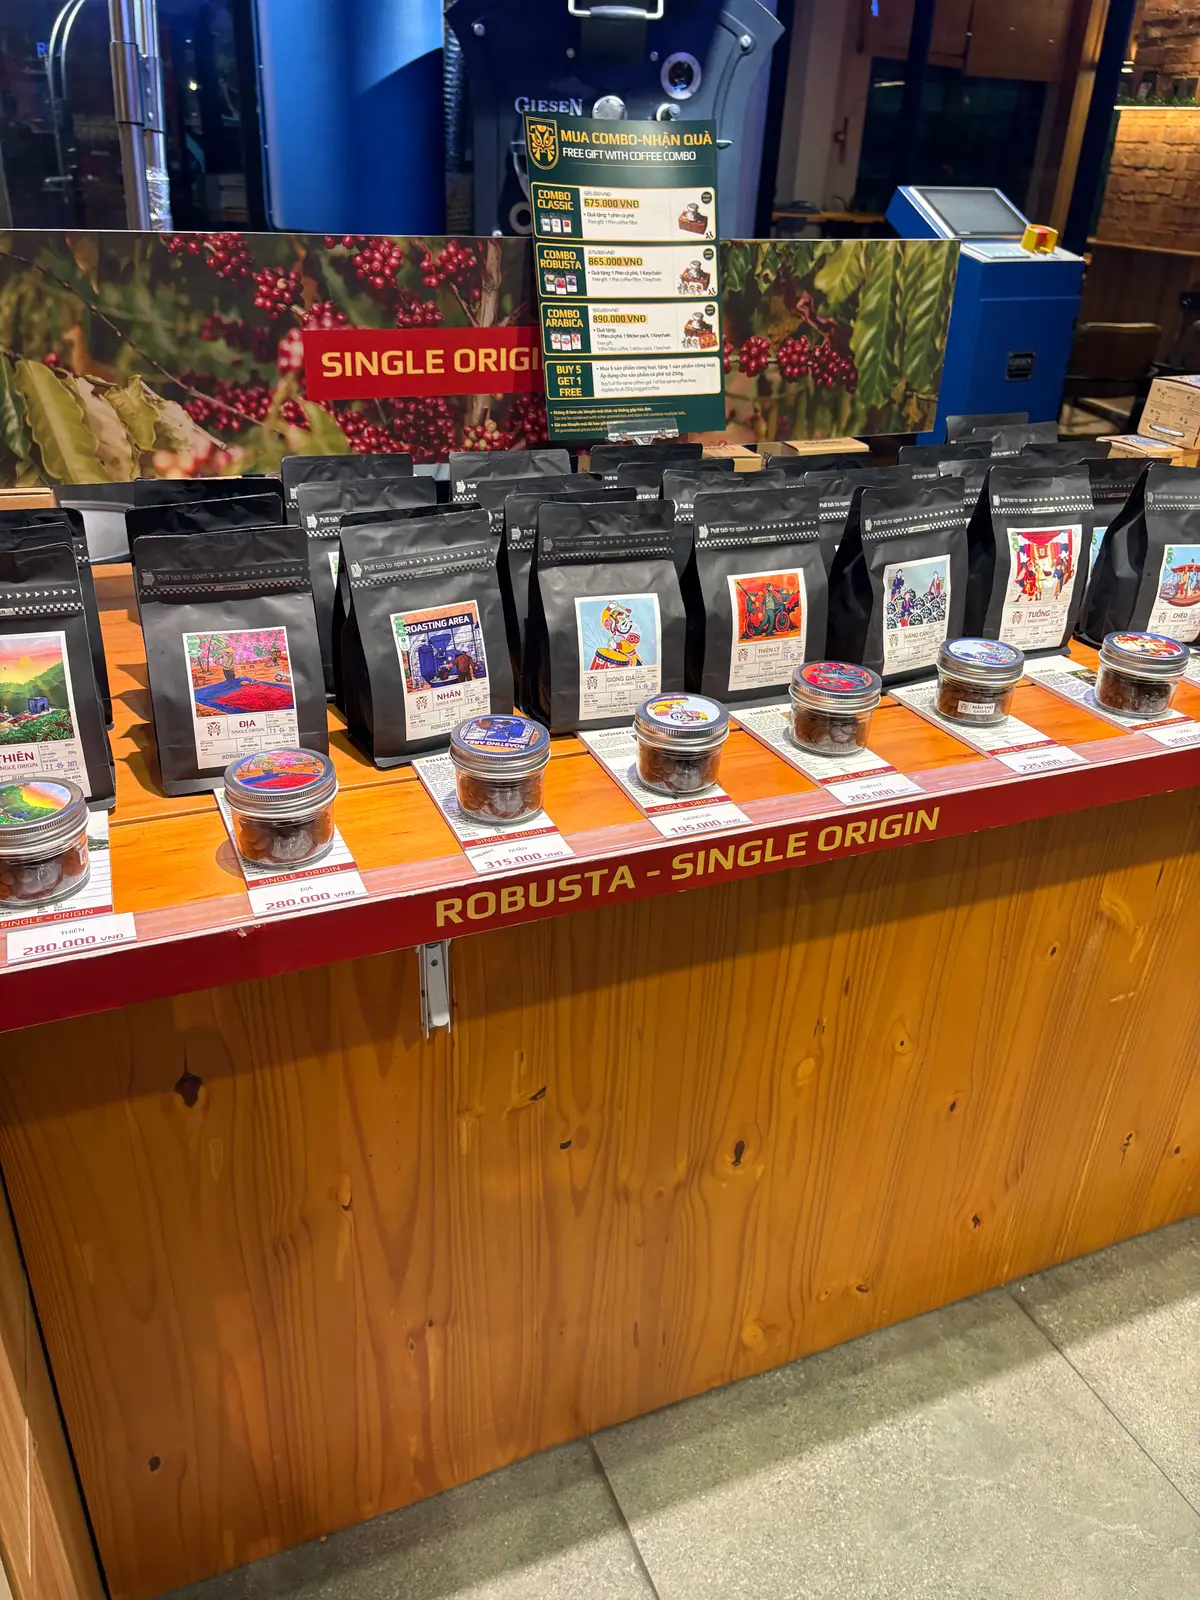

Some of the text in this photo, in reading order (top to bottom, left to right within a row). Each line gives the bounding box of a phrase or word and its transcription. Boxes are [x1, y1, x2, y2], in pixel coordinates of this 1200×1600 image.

[514, 96, 583, 116] GIESEN
[560, 130, 712, 148] MUA COMBO-NHẬN QUÀ
[562, 148, 696, 162] FREE GIFT WITH COFFEE COMBO
[538, 189, 571, 200] COMBO
[538, 200, 574, 211] CLASSIC
[584, 198, 640, 208] 675.000 VNĐ
[544, 250, 576, 260] COMBO
[540, 259, 582, 270] ROBUSTA
[588, 257, 643, 266] 865.000 VNĐ
[547, 309, 580, 318] COMBO
[593, 315, 626, 323] 890.000
[546, 318, 583, 328] ARABICA
[320, 346, 541, 378] SINGLE ORIGI
[556, 365, 582, 374] BUY 5
[558, 376, 581, 385] GET 1
[560, 388, 582, 397] FREE
[364, 564, 375, 572] Pull
[393, 560, 407, 568] open
[406, 615, 470, 634] ROASTING AREA
[437, 690, 461, 700] NHÂN
[239, 720, 256, 729] ĐỊA
[0, 751, 34, 763] HIÊN
[848, 789, 896, 801] 265.000
[671, 820, 721, 834] 195.000
[475, 829, 547, 845] SINGLE ORIGIN
[485, 852, 542, 869] 315.000
[434, 864, 636, 928] ROBUSTA
[672, 838, 808, 882] SINGLE
[818, 806, 941, 851] ORIGIN
[259, 866, 341, 885] SINGLE ORIGIN
[265, 892, 330, 910] 280.000
[0, 917, 42, 928] SINGLE
[53, 909, 94, 919] ORIGIN
[23, 936, 96, 956] 280.000
